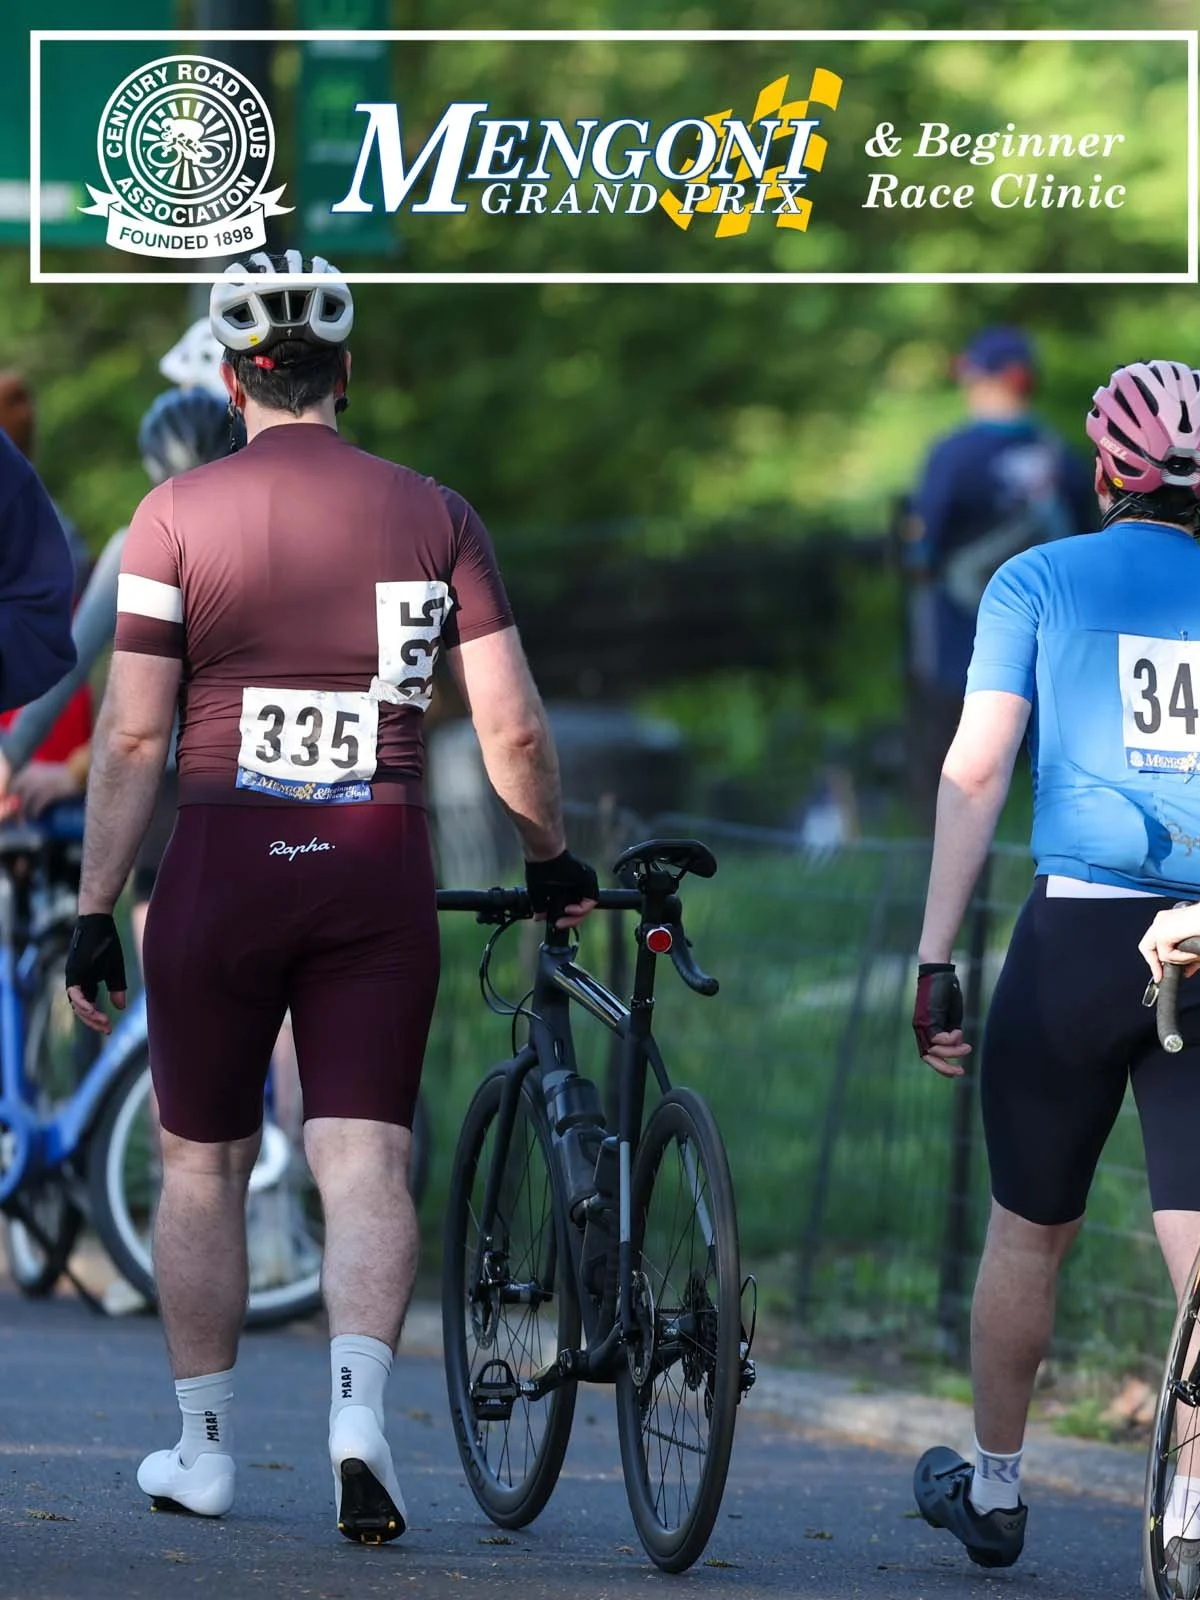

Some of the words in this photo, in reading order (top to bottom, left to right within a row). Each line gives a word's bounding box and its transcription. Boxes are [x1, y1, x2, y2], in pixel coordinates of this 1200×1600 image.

[255, 704, 360, 769] 335
[341, 1366, 353, 1398] MAAP
[204, 1410, 220, 1442] MAAP
